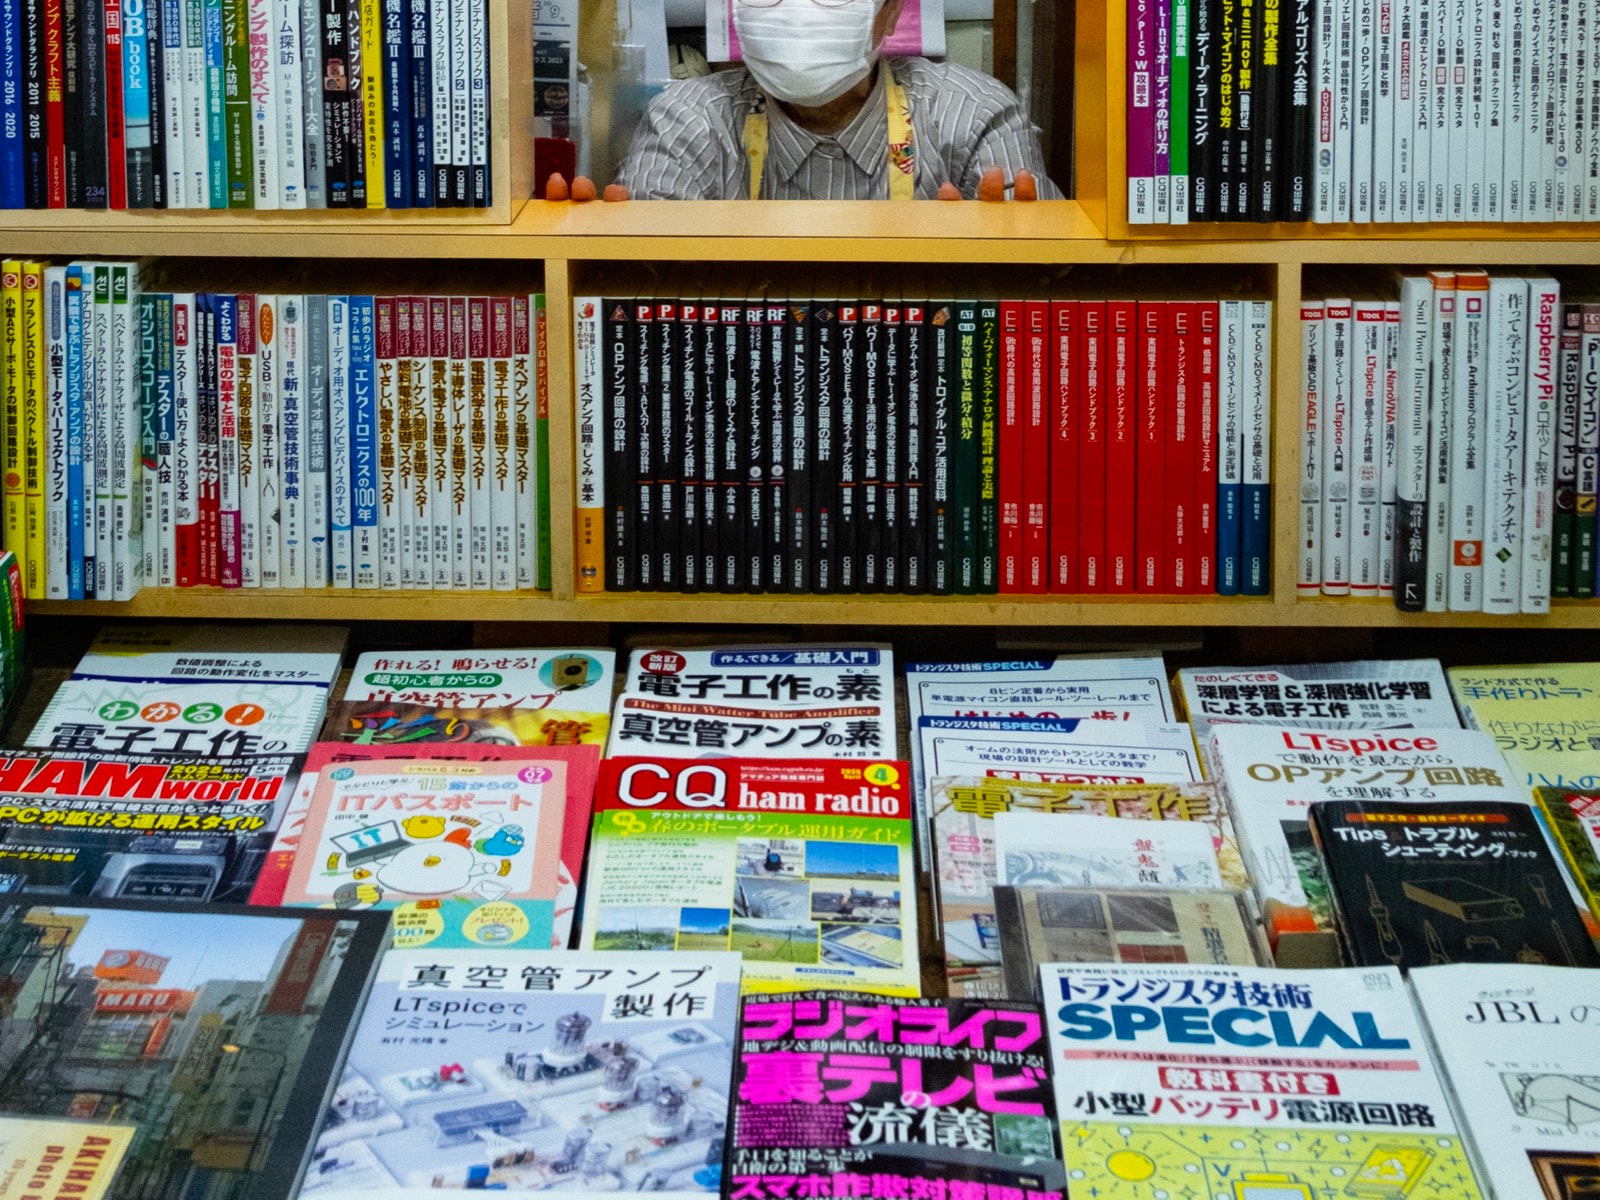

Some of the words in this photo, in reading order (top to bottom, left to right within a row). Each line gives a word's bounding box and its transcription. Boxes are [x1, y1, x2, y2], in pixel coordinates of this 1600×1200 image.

[128, 41, 142, 90] book
[347, 11, 362, 91] ハンドブック
[1194, 32, 1211, 146] ディープ・ラーニング
[1136, 178, 1146, 215] CQ出版社
[1195, 177, 1206, 214] CQ出版社
[1292, 176, 1303, 213] CQ出版社
[220, 300, 233, 342] よくわかる
[1303, 310, 1323, 319] TOOL
[1330, 309, 1349, 318] TOOL
[1416, 299, 1429, 326] Soul
[1533, 293, 1556, 383] Raspberry
[5, 296, 19, 469] 小型ACサーボ・モータの制御回路設計
[141, 301, 156, 456] オシロスコープ入門
[537, 319, 549, 415] マイクロホンバイブル
[960, 334, 974, 441] 初等関数と微分・積分
[25, 298, 38, 490] ブラシレスDCモータのベクトル制御技術
[219, 345, 235, 439] 電池の基本と活用
[261, 350, 275, 470] USBで動かす電子工作
[613, 341, 627, 452] OPアンプ回路の設計
[793, 354, 805, 471] トランジスタ回路の設計
[818, 344, 831, 462] トランジスタ回路の設計
[1412, 368, 1426, 437] Instruments
[1560, 352, 1580, 438] Raspberry
[50, 342, 65, 503] 小型モータ・パーフェクトブック
[310, 363, 325, 470] オーディオ再生技術
[397, 359, 412, 490] 燃料電池の基礎マスター
[431, 360, 448, 493] 電気・電子の基礎マスター
[470, 360, 486, 491] 電磁気学の基礎マスター
[493, 360, 510, 492] 電子工作の基礎マスター
[513, 357, 530, 495] オペアンプの基礎マスター
[1499, 293, 1524, 545] 作って学ぶコンピュータアーキテクチャ
[283, 376, 300, 501] 新・真空管技術事典
[353, 367, 376, 522] エレクトロニクスの100年
[378, 362, 396, 517] やさしい電気の基礎マスター
[412, 360, 429, 518] シーケンス制御の基礎マスター
[451, 362, 467, 517] 半導体レーザの基礎マスター
[580, 382, 595, 504] オペアンプ回路のしくみと基本
[934, 374, 948, 502] トロイダル・コア活用百科
[170, 666, 321, 679] 回路の動作変化をマスター
[175, 657, 263, 669] 数値調整による
[373, 658, 442, 671] 作れる！
[451, 656, 538, 671] 鳴らせる！
[647, 660, 678, 672] 新版
[648, 652, 679, 664] 改訂
[371, 673, 496, 687] 超初心者からの
[638, 673, 882, 702] 電子工作の素
[632, 699, 659, 710] The
[661, 702, 698, 714] Mini
[702, 704, 752, 716] Watter
[760, 708, 796, 719] Tube
[802, 706, 876, 718] Amplifier
[1201, 700, 1351, 718] による電子工作
[619, 712, 881, 749] 真空管アンプの素
[1282, 731, 1438, 758] LTspice
[170, 764, 223, 775] 2025
[873, 766, 889, 782] 4
[978, 753, 1147, 769] 現場の設計ツールとしての数学
[1246, 764, 1505, 788] OPアンプ回路
[1275, 753, 1455, 768] で動作を見ながら
[159, 776, 287, 801] world
[336, 793, 535, 812] ITパスポート
[617, 762, 728, 810] CQ
[738, 782, 812, 811] ham
[815, 786, 900, 816] radio
[1324, 786, 1437, 800] を理解する
[0, 806, 267, 831] PCが拡げる運用スタイル
[652, 820, 903, 842] 春のポータブル運用ガイド
[1332, 825, 1389, 844] Tips
[1402, 825, 1480, 843] トラブル
[412, 962, 714, 993] 真空管アンプ
[1059, 976, 1314, 1009] トランジスタ技術
[385, 1014, 546, 1034] シミュレーション
[392, 996, 528, 1021] LTspiceで
[611, 992, 709, 1019] 製作
[742, 1000, 1043, 1053] ラジオライフ
[1057, 1003, 1412, 1051] SPECIAL
[738, 1051, 1048, 1116] 裏テレビ
[1165, 1067, 1335, 1096] 教科書付き
[846, 1101, 993, 1153] 流儀
[1074, 1090, 1437, 1130] 小型バッテリ電源回路
